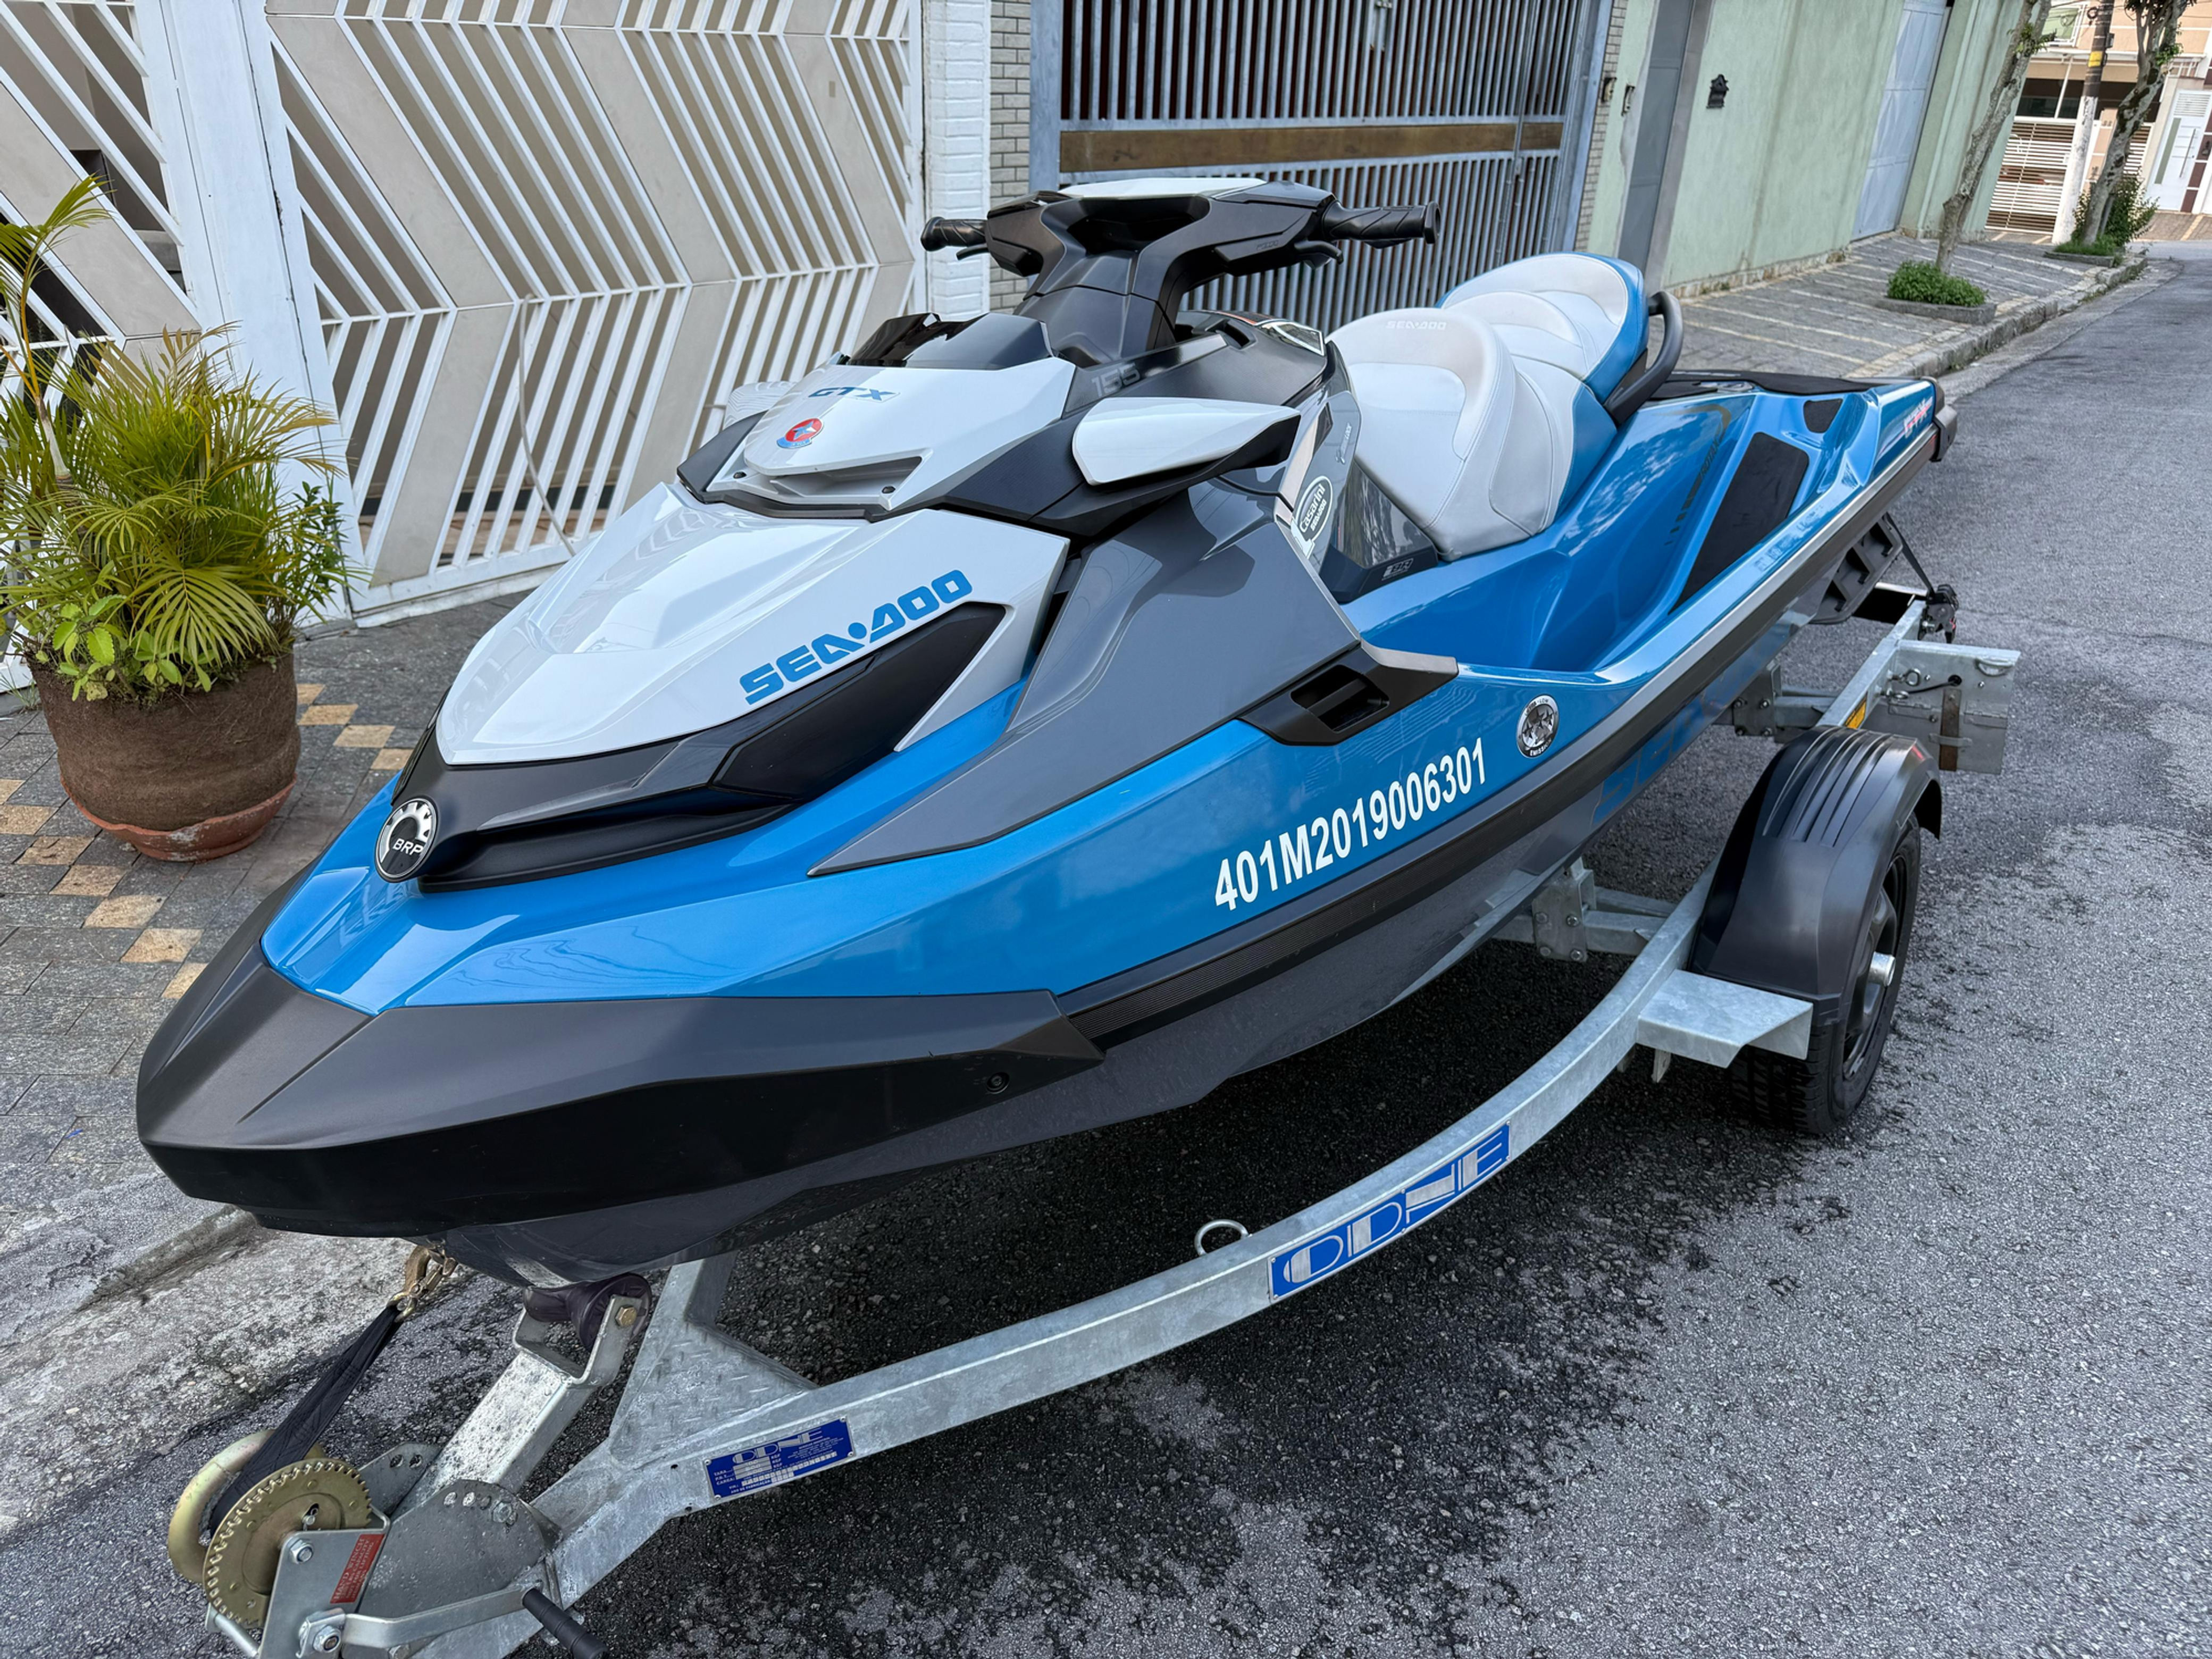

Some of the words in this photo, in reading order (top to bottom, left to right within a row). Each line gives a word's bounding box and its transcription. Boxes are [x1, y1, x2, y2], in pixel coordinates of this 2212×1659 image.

[808, 387, 896, 401] GTX
[1091, 362, 1140, 397] 155
[1299, 483, 1326, 533] Casarini
[1215, 738, 1486, 911] 401M2019006301
[393, 839, 424, 856] BRP
